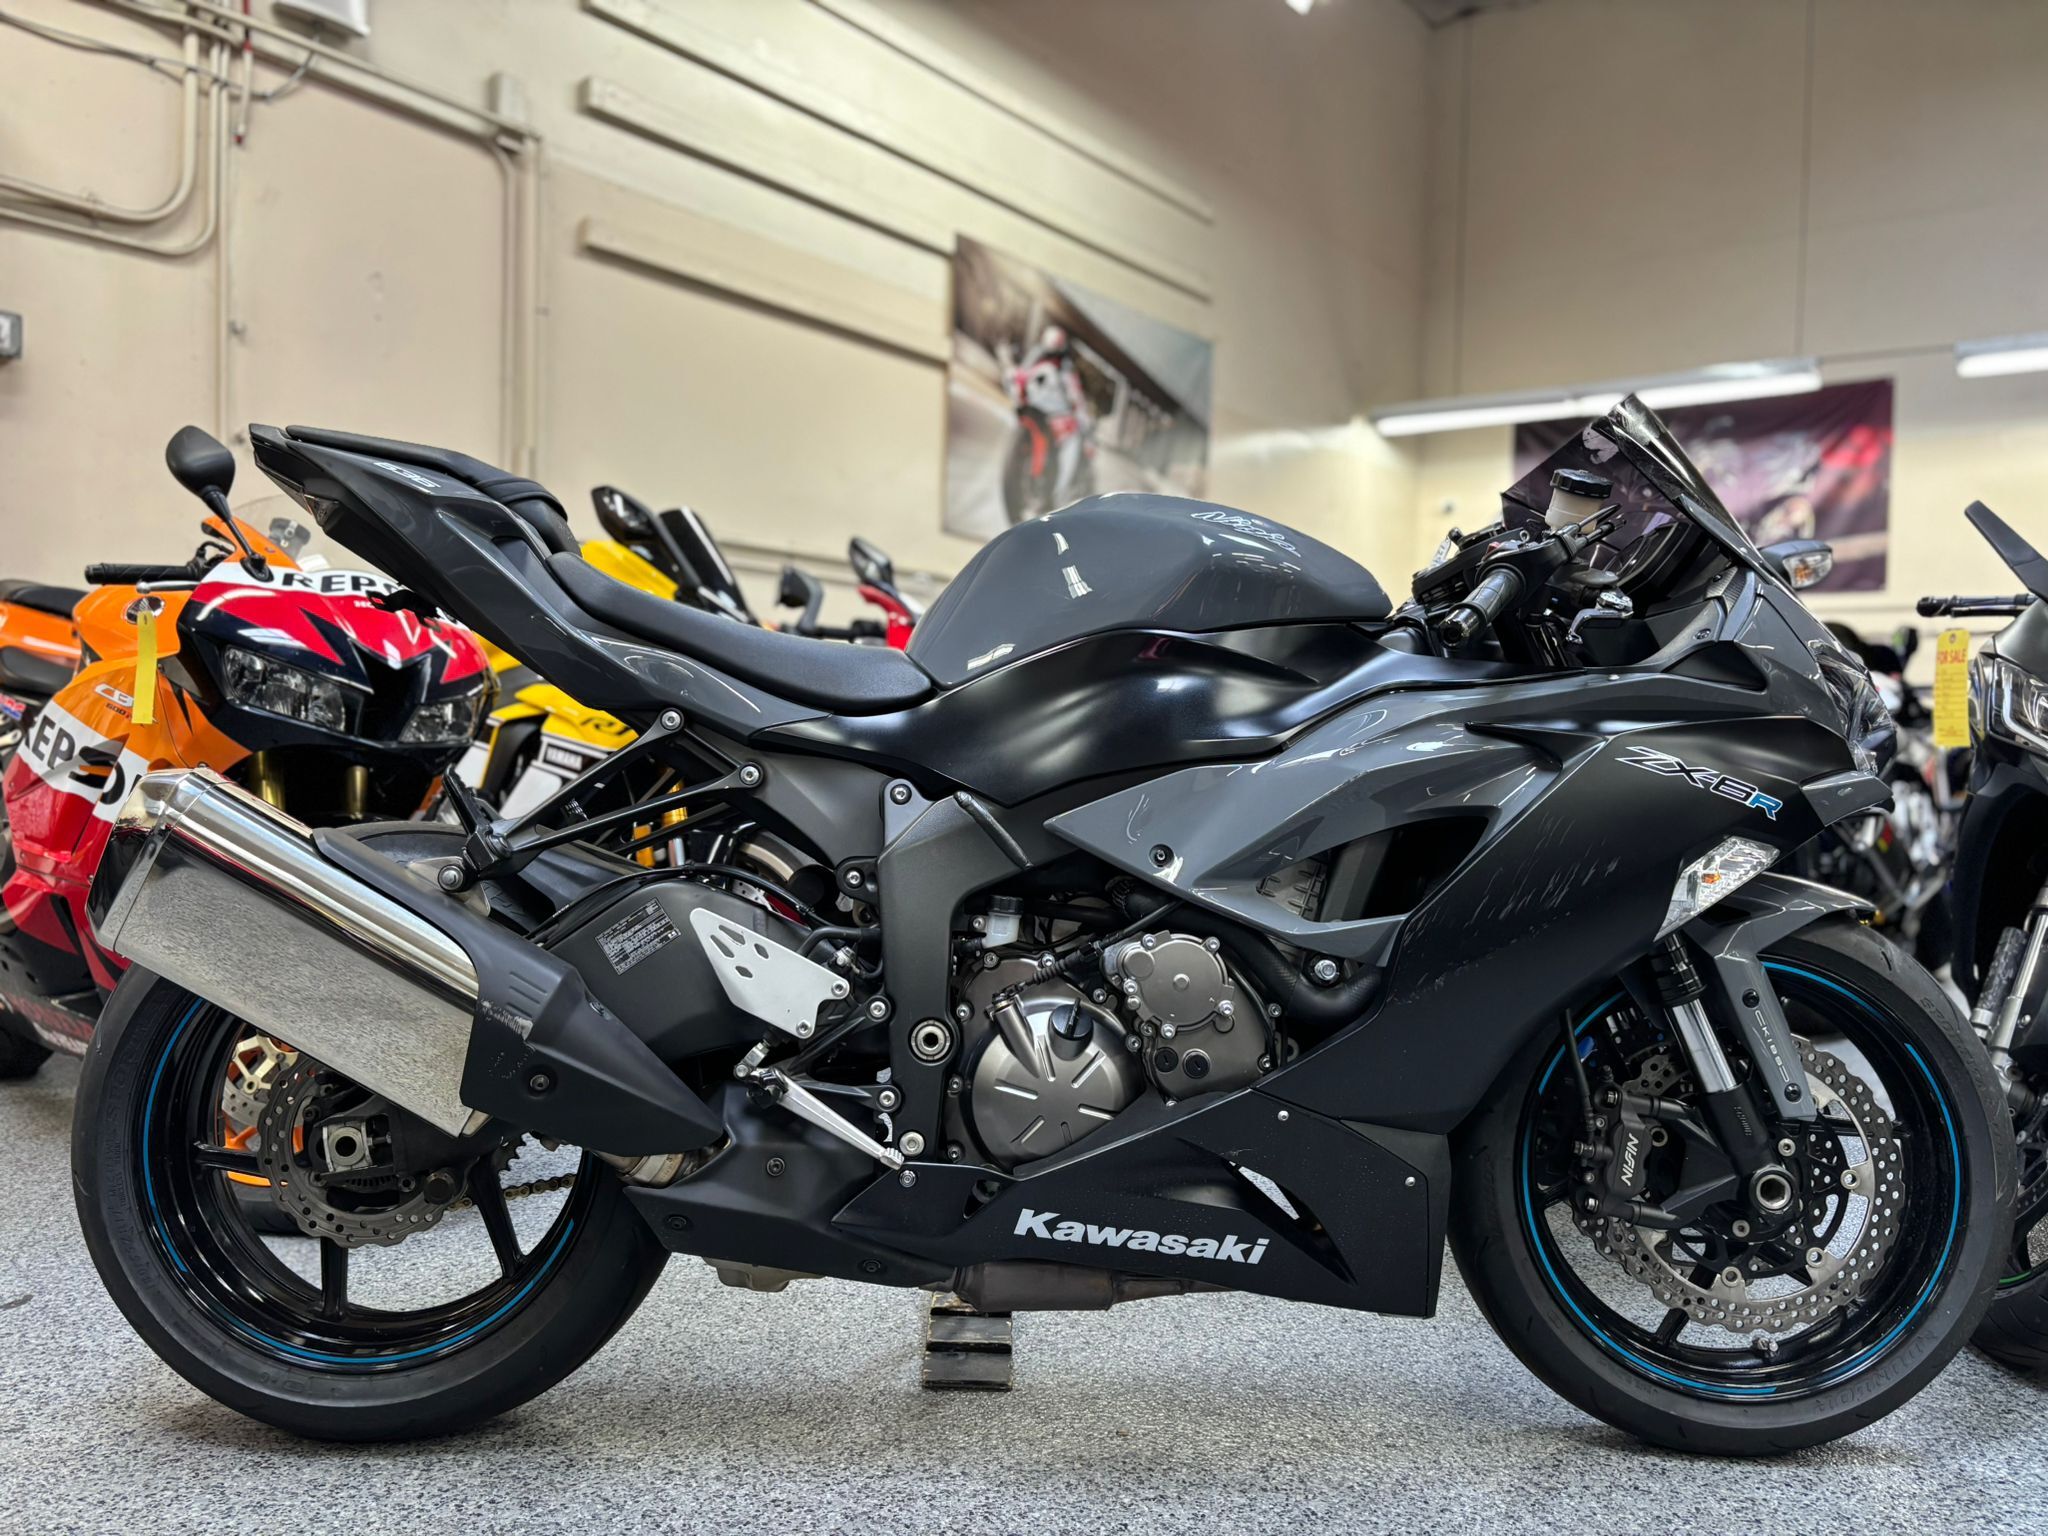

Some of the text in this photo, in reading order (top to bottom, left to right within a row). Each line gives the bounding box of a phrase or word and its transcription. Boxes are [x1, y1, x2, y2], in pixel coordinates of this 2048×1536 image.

[373, 462, 441, 488] 636
[1190, 511, 1301, 558] Ninja
[1614, 746, 1783, 822] ZX-6R
[1621, 1132, 1639, 1187] NISSIN
[1013, 1208, 1270, 1265] Kawasaki
